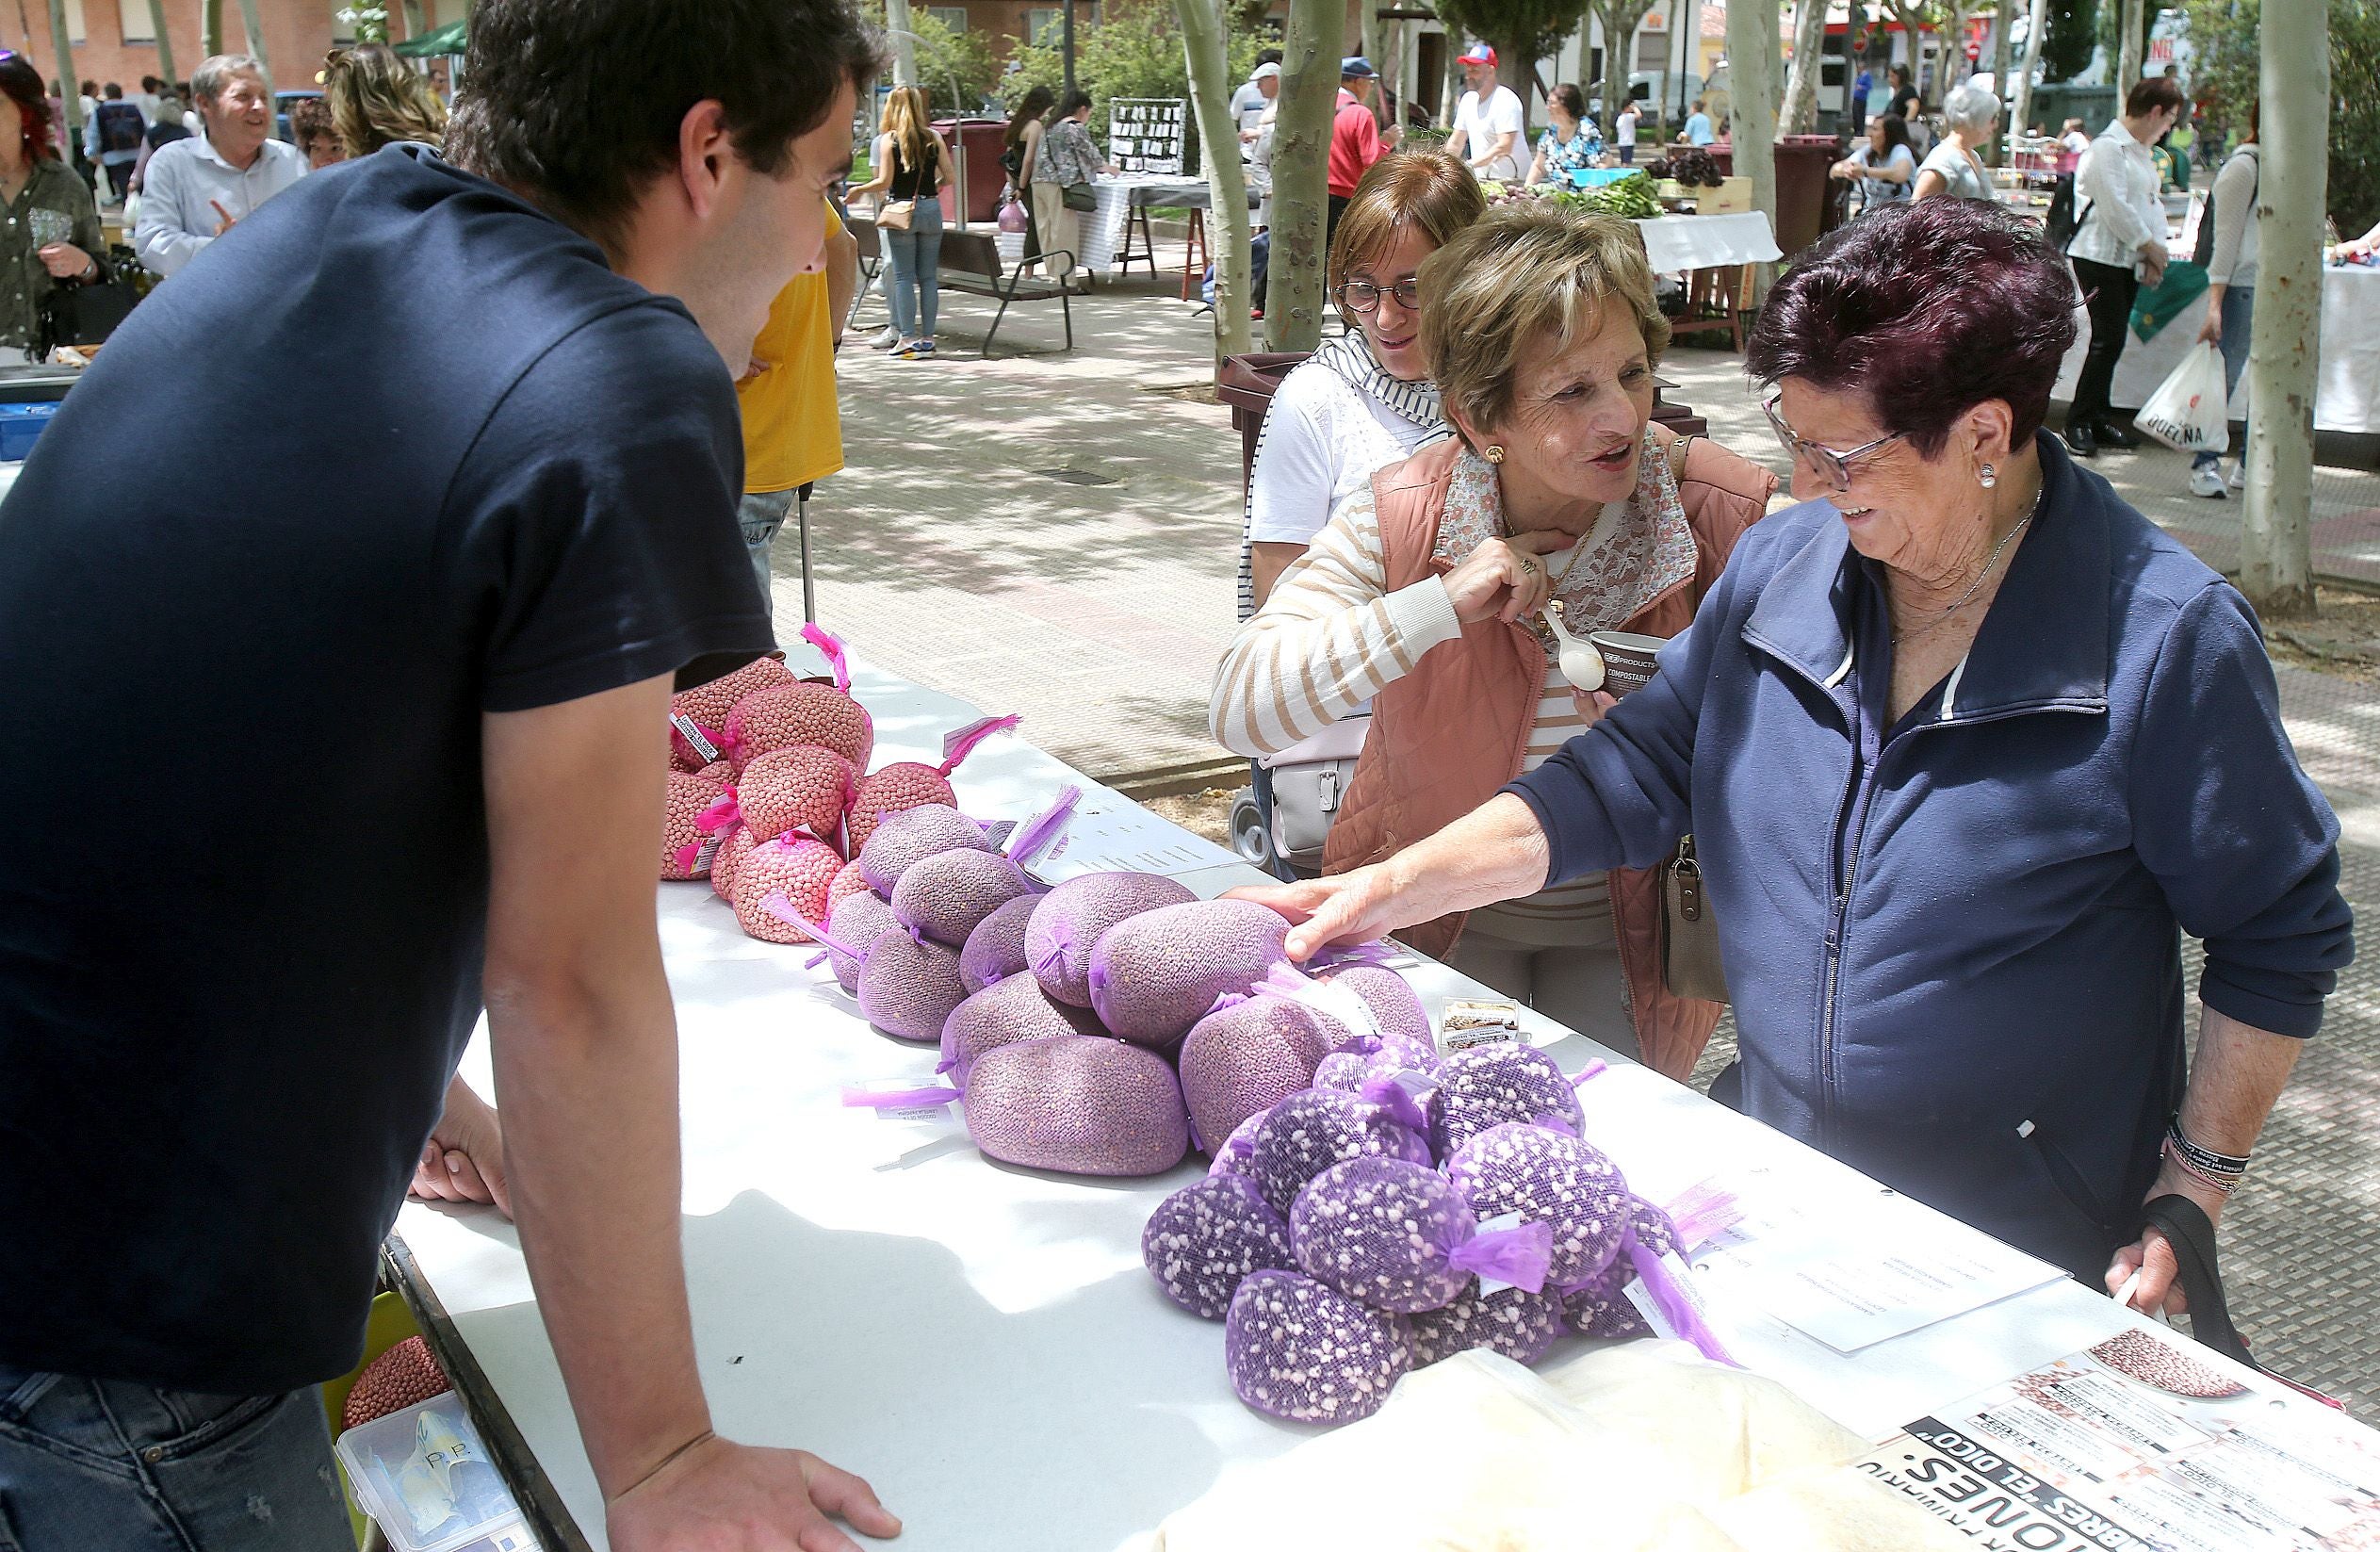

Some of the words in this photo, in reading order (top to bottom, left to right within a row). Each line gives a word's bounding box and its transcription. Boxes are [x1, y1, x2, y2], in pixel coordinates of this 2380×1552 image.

[1620, 657, 1656, 668] PRODUCTS
[1608, 668, 1652, 682] COMPOSTABLE
[1915, 1430, 2004, 1474] DICO"
[2174, 1466, 2217, 1489] DICO"
